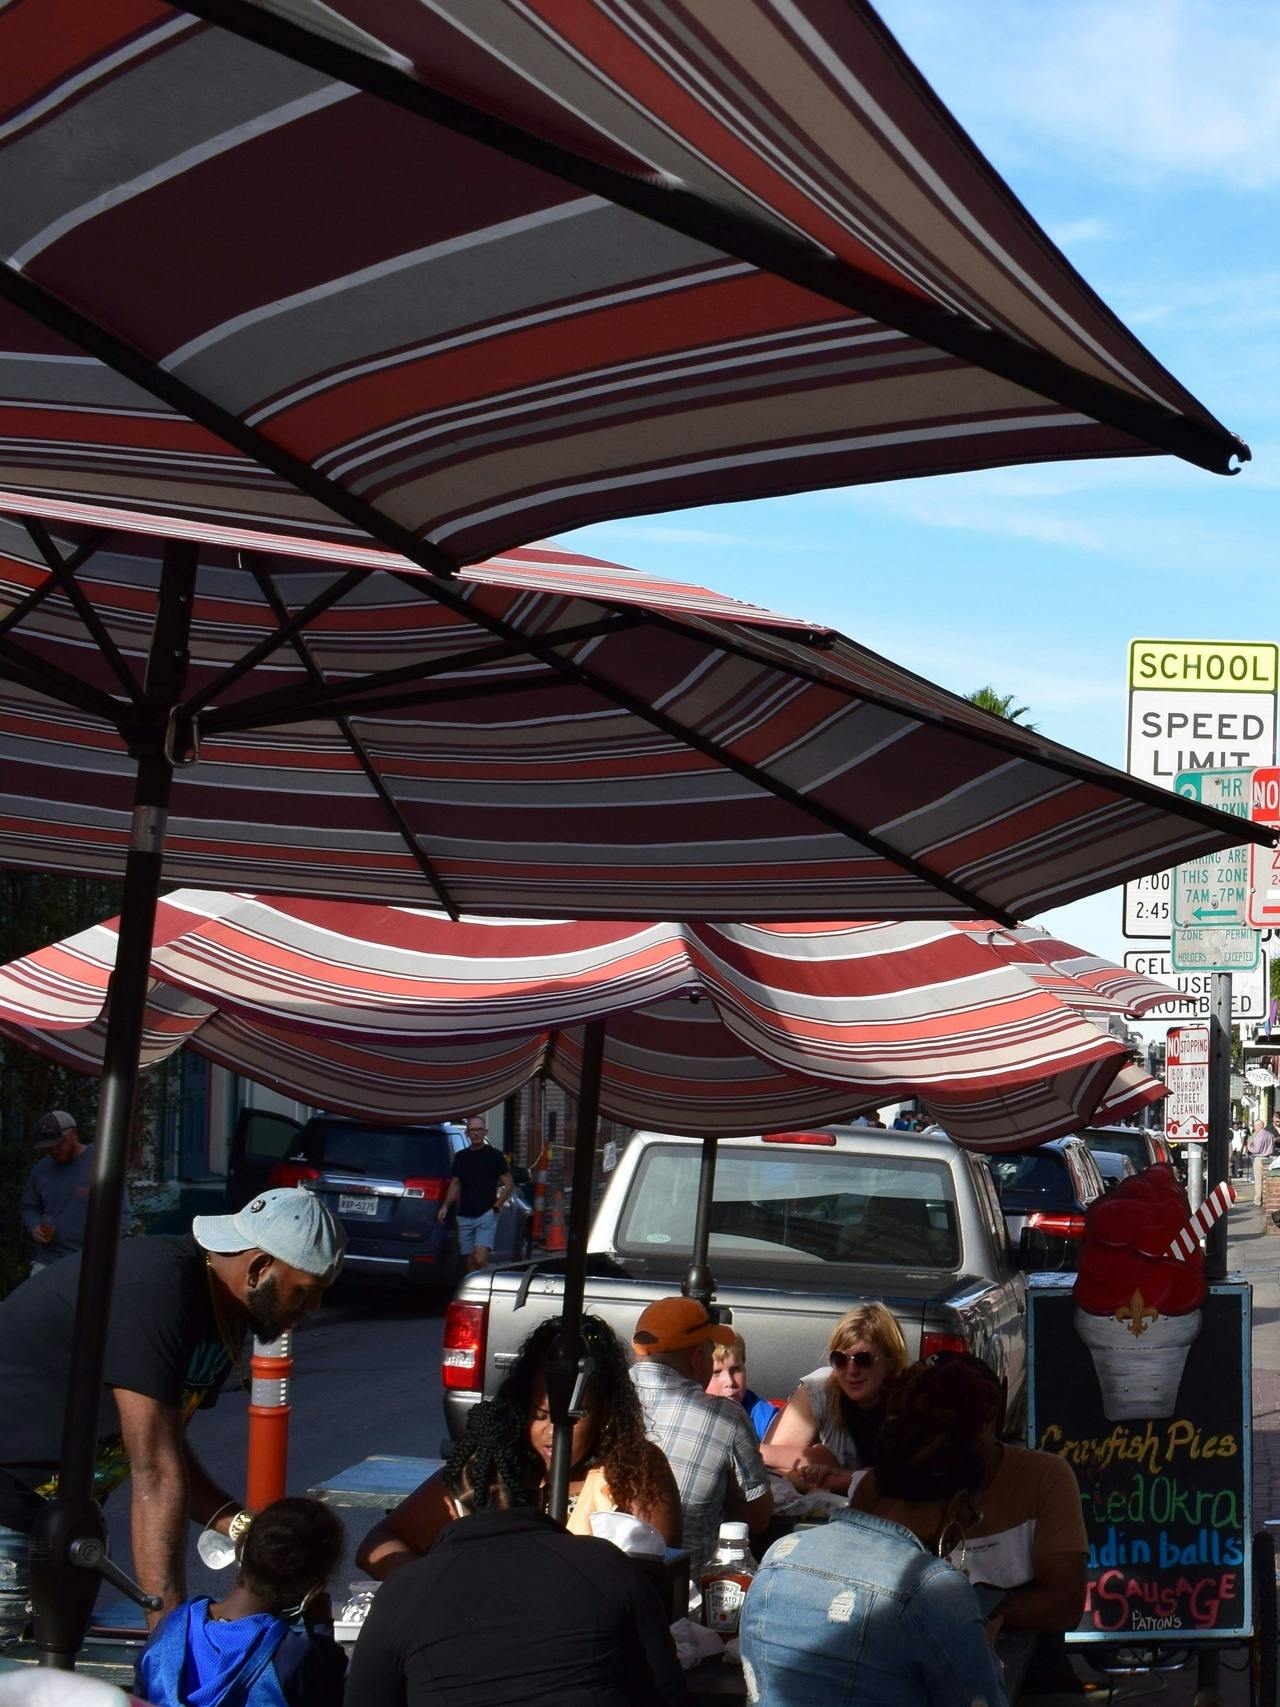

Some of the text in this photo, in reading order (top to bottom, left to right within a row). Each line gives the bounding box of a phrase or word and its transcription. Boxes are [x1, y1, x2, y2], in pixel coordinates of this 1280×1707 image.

[1139, 653, 1269, 681] SCHOOL
[1141, 712, 1264, 740] SPEED
[1153, 750, 1250, 776] LIMIT
[1221, 778, 1243, 797] HR
[1254, 780, 1279, 810] NO
[1182, 868, 1248, 884] THIS ZONE
[1136, 902, 1169, 919] 2:45
[1181, 929, 1253, 941] ZONE PERMIT
[1224, 951, 1254, 961] EXCEPTED
[1135, 958, 1176, 974] CEL
[1177, 977, 1211, 994] USE
[1168, 1037, 1208, 1058] NO STOPPING
[1173, 1081, 1204, 1093] THURSDAY
[1176, 1093, 1200, 1104] STREET
[1172, 1104, 1205, 1115] CLEANING
[1165, 1420, 1238, 1462] Pies
[1080, 1473, 1243, 1529] ried Okra
[1087, 1525, 1244, 1568] udin balls
